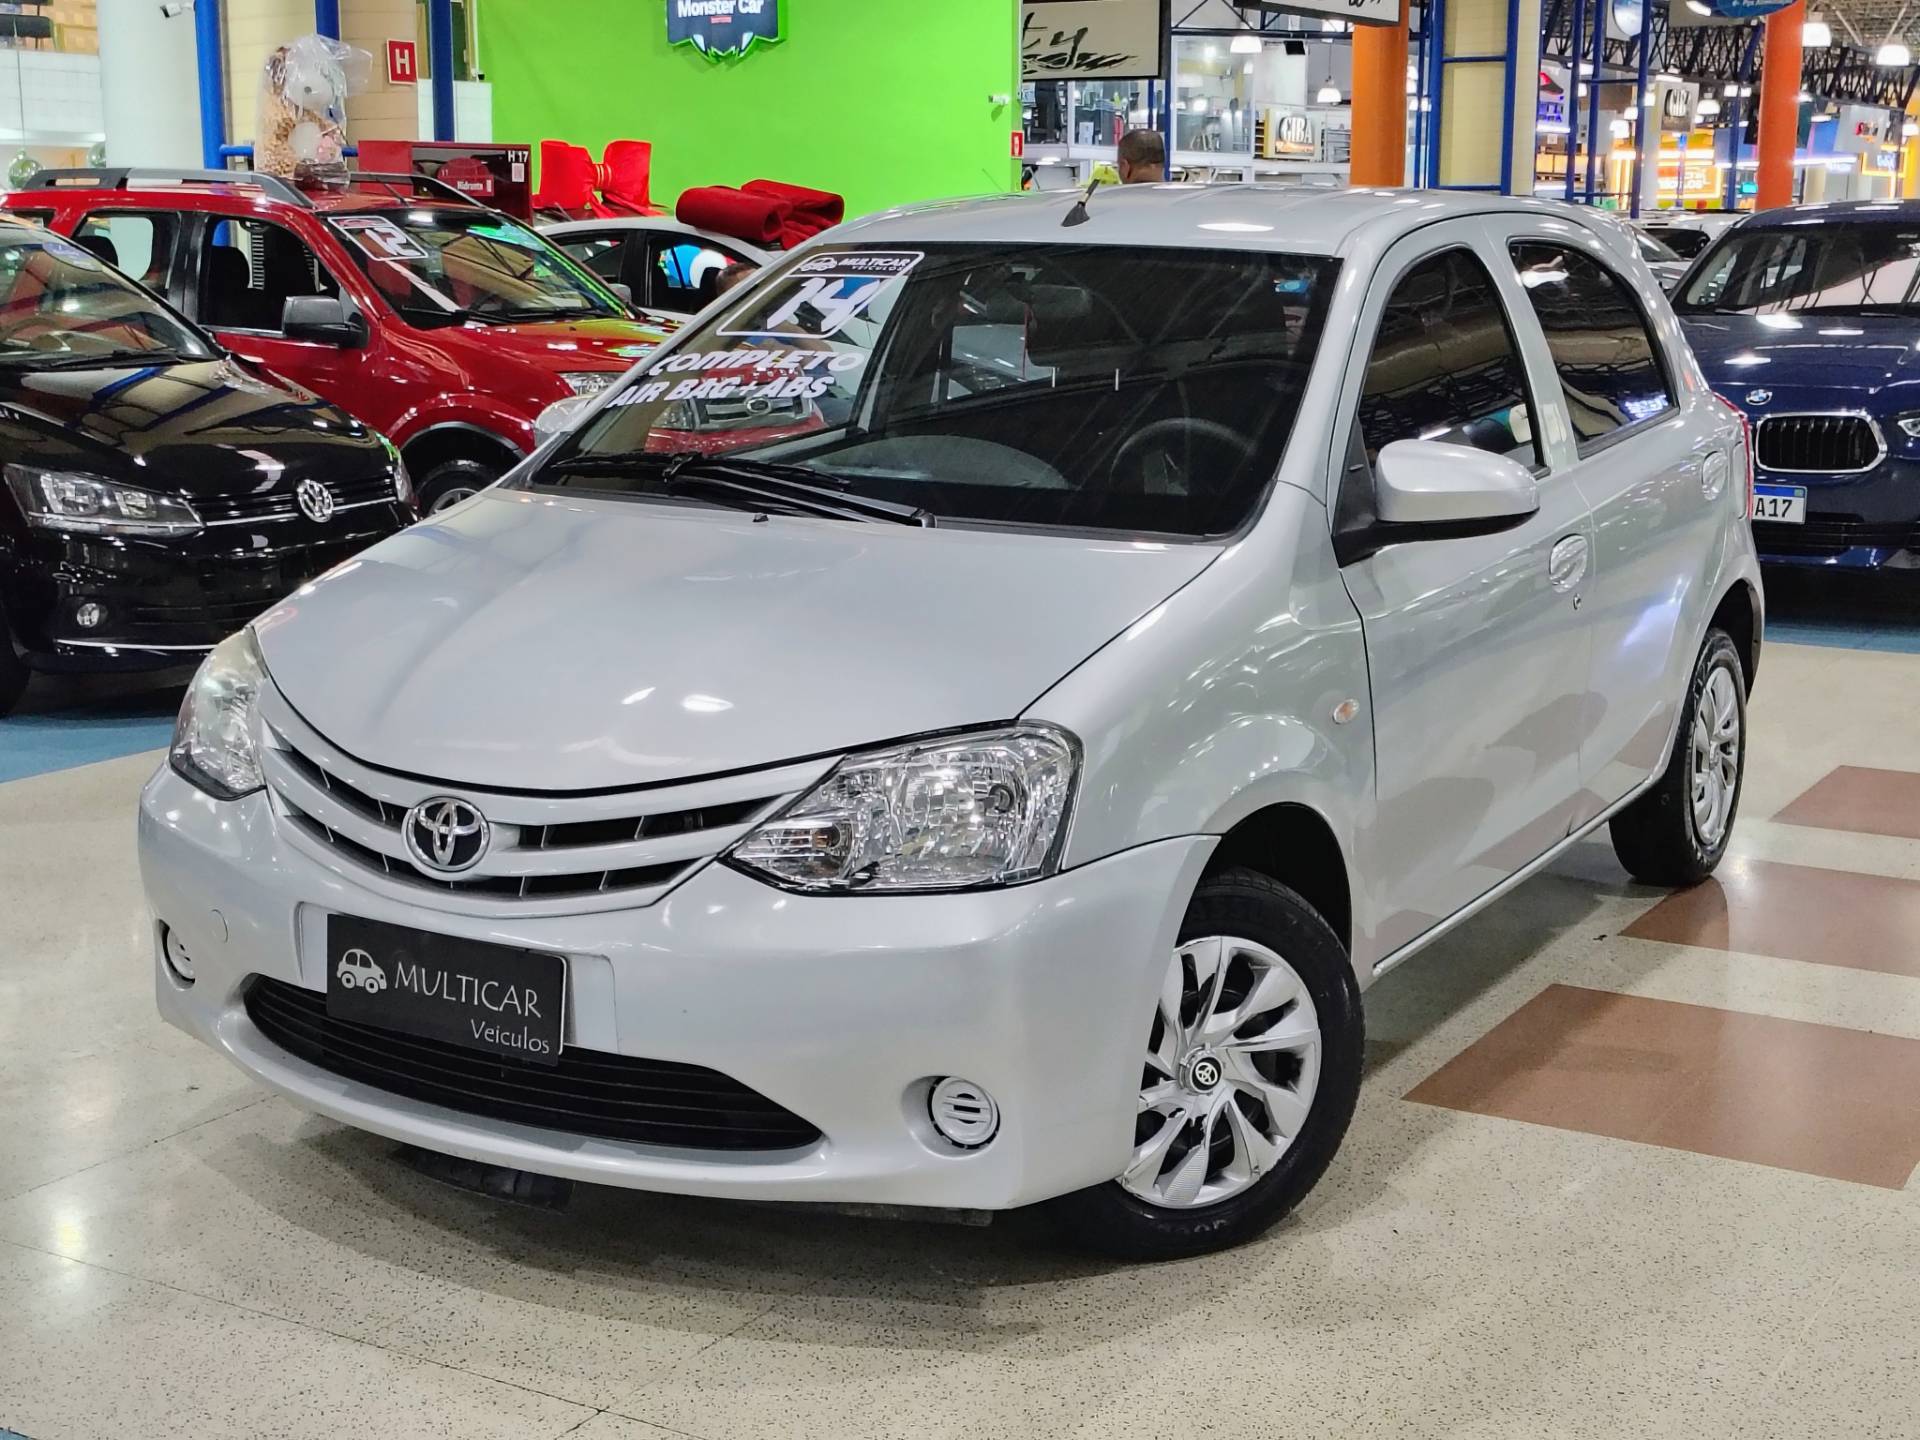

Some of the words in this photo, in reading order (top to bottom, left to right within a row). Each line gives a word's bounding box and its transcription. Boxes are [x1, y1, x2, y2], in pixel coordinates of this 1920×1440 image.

[677, 0, 736, 17] Monster
[738, 0, 764, 14] Car
[395, 48, 410, 75] H
[507, 150, 516, 162] H
[518, 150, 529, 163] 17
[838, 257, 911, 267] MULTICAR
[766, 277, 881, 332] 14
[648, 350, 866, 377] COMPLETO
[394, 961, 542, 1019] MULTICAR
[470, 1018, 550, 1054] Veiculos
